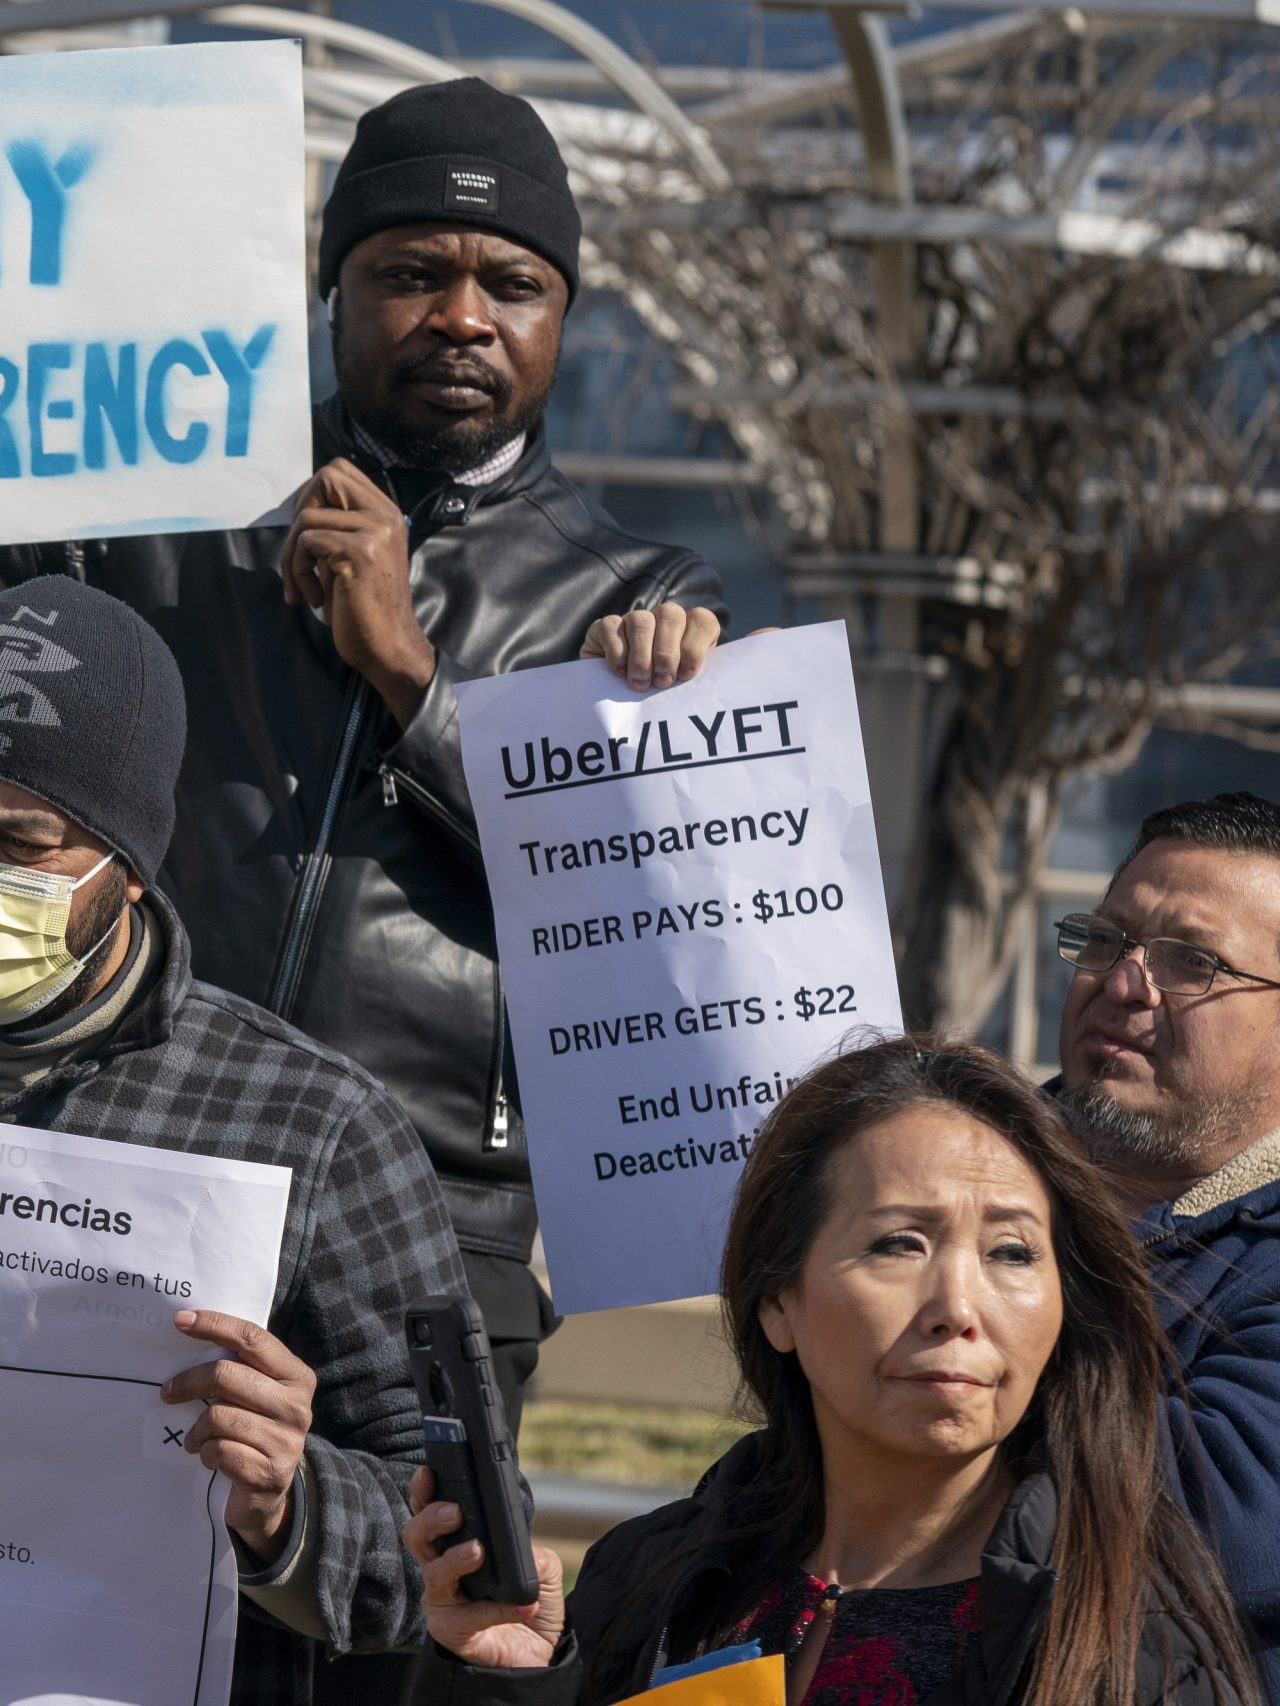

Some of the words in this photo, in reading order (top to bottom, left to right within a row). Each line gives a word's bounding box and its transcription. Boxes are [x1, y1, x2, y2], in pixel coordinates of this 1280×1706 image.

[500, 700, 800, 791] Uber/LYFT
[518, 808, 809, 876] Transparency
[532, 916, 624, 956] RIDER
[632, 900, 723, 940] PAYS
[752, 884, 843, 924] $100
[549, 1012, 666, 1055] DRIVER
[674, 997, 765, 1036] GETS
[794, 985, 857, 1022] $22
[618, 1087, 680, 1124] End
[594, 1127, 761, 1184] Deactivat
[116, 1271, 145, 1290] en
[153, 1272, 193, 1299] tus
